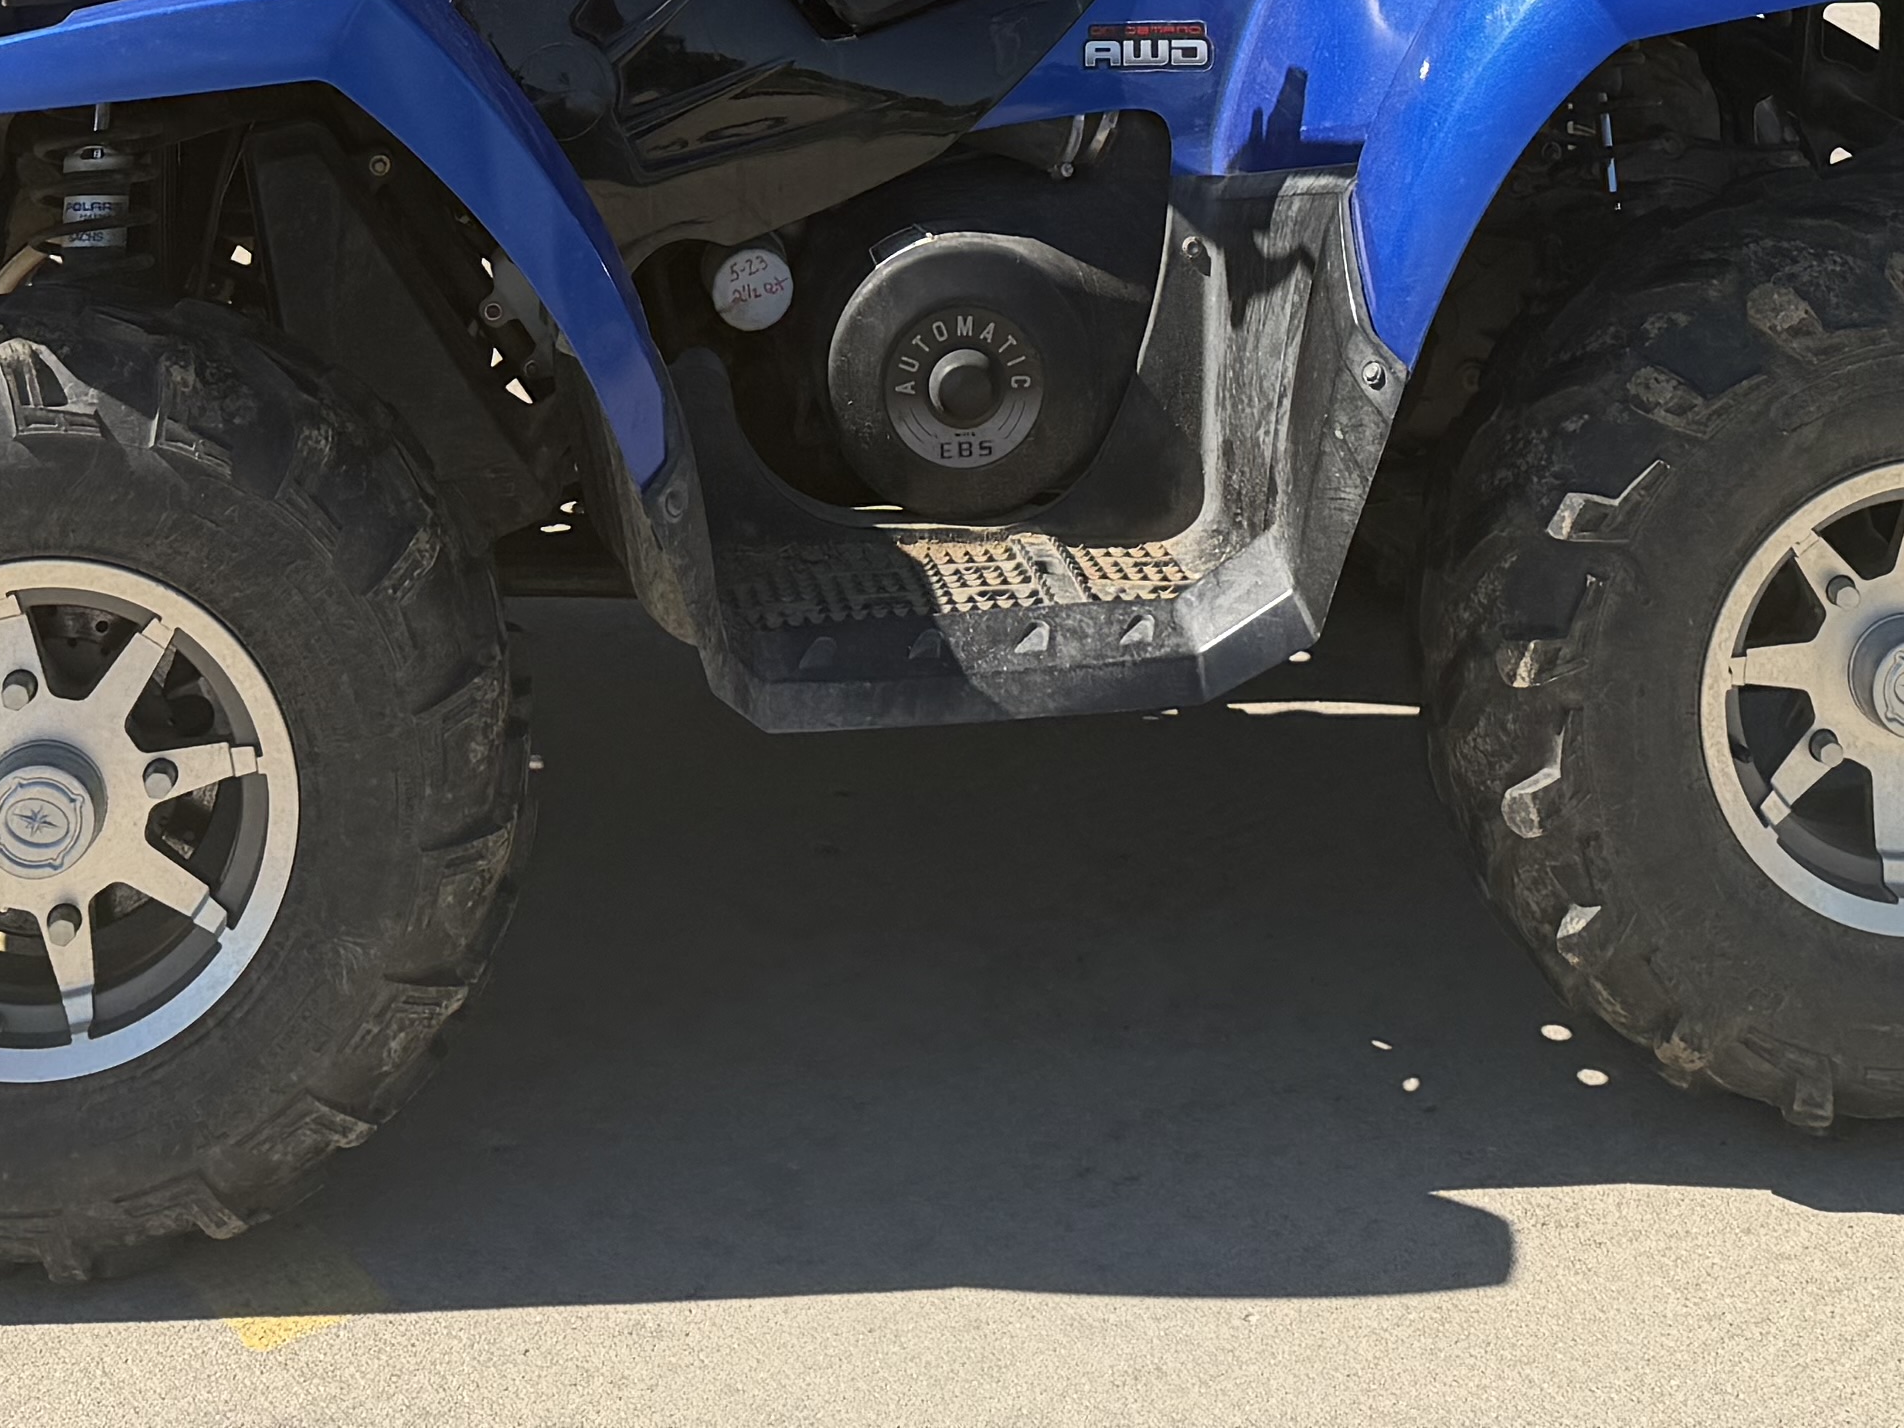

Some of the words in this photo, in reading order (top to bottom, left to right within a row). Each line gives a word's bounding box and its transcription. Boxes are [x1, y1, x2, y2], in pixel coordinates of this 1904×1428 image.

[1084, 39, 1208, 67] AWD
[729, 255, 769, 283] 5-23
[894, 315, 1032, 395] AUTOMATIC
[939, 439, 994, 460] EBS
